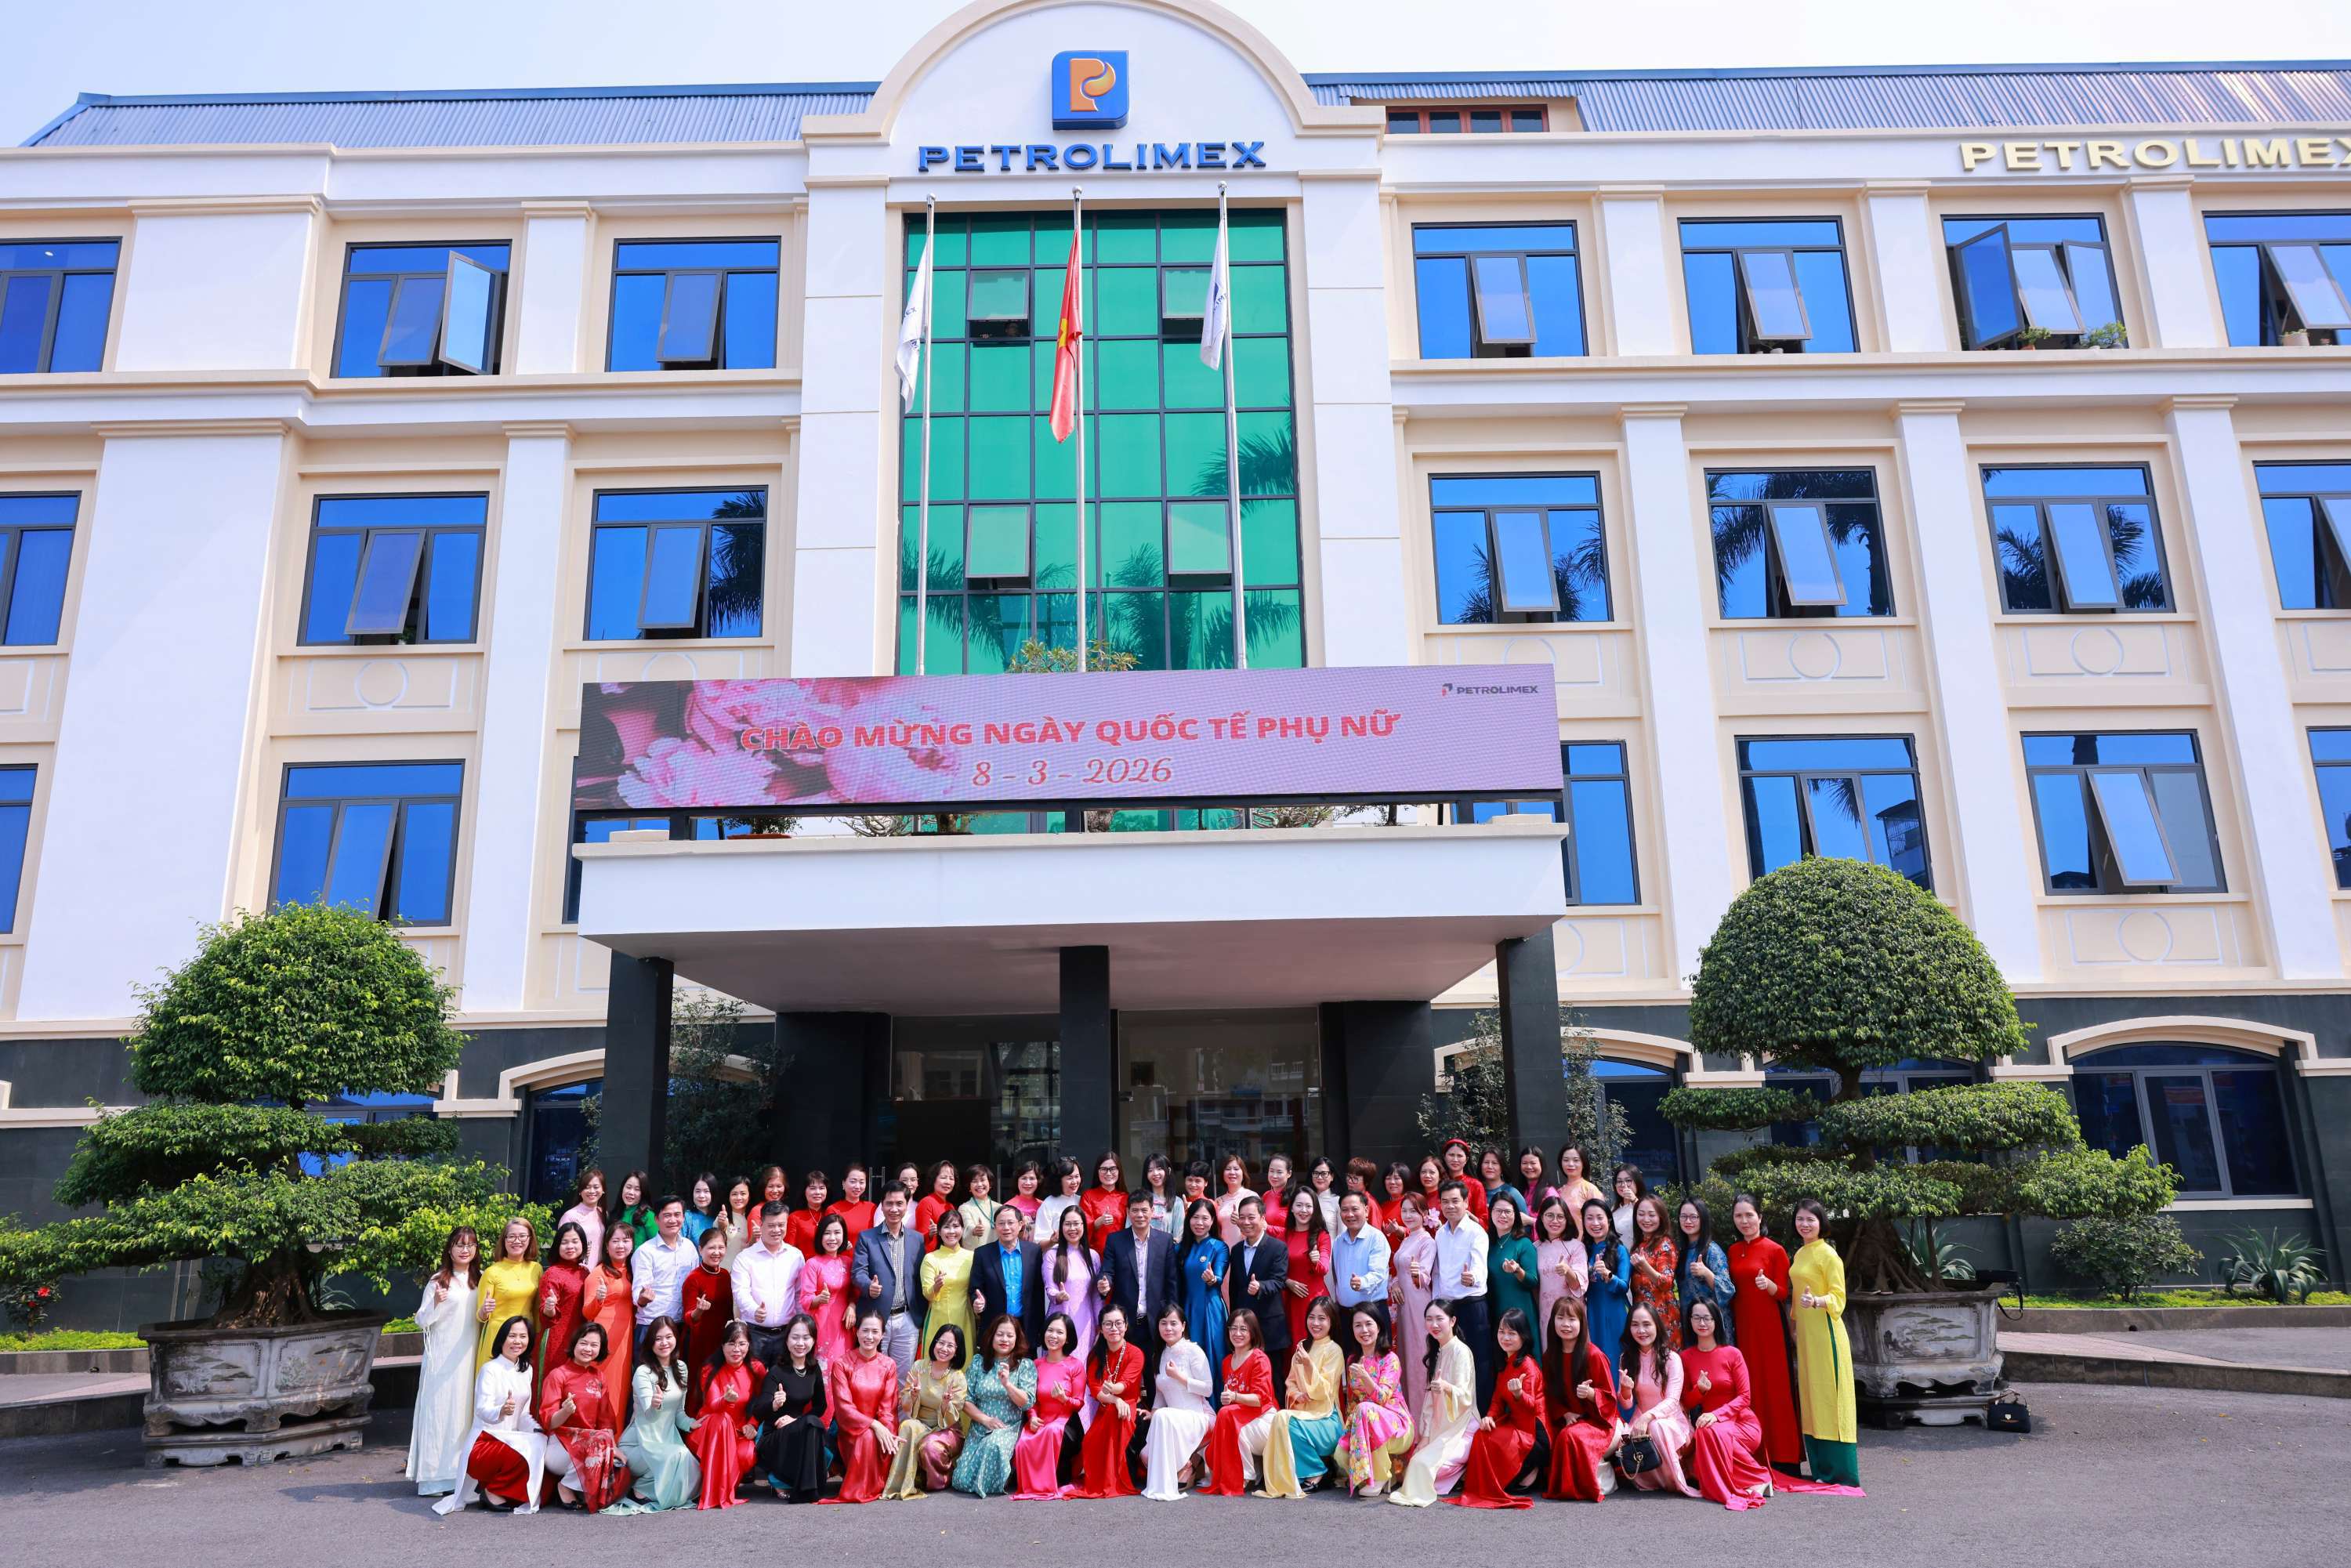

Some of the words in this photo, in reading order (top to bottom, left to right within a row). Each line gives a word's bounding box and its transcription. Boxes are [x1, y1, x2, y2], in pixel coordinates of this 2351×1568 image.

[918, 142, 1266, 172] PETROLIMEX
[1456, 685, 1538, 695] PETROLIMEX
[741, 722, 843, 750] CHÀO
[854, 718, 973, 747] MỪNG
[984, 715, 1086, 744] NGÀY
[1096, 712, 1198, 746] QUỐC
[1208, 711, 1251, 740] TẾ
[1257, 715, 1330, 744] PHỤ
[1341, 709, 1402, 737] NỮ
